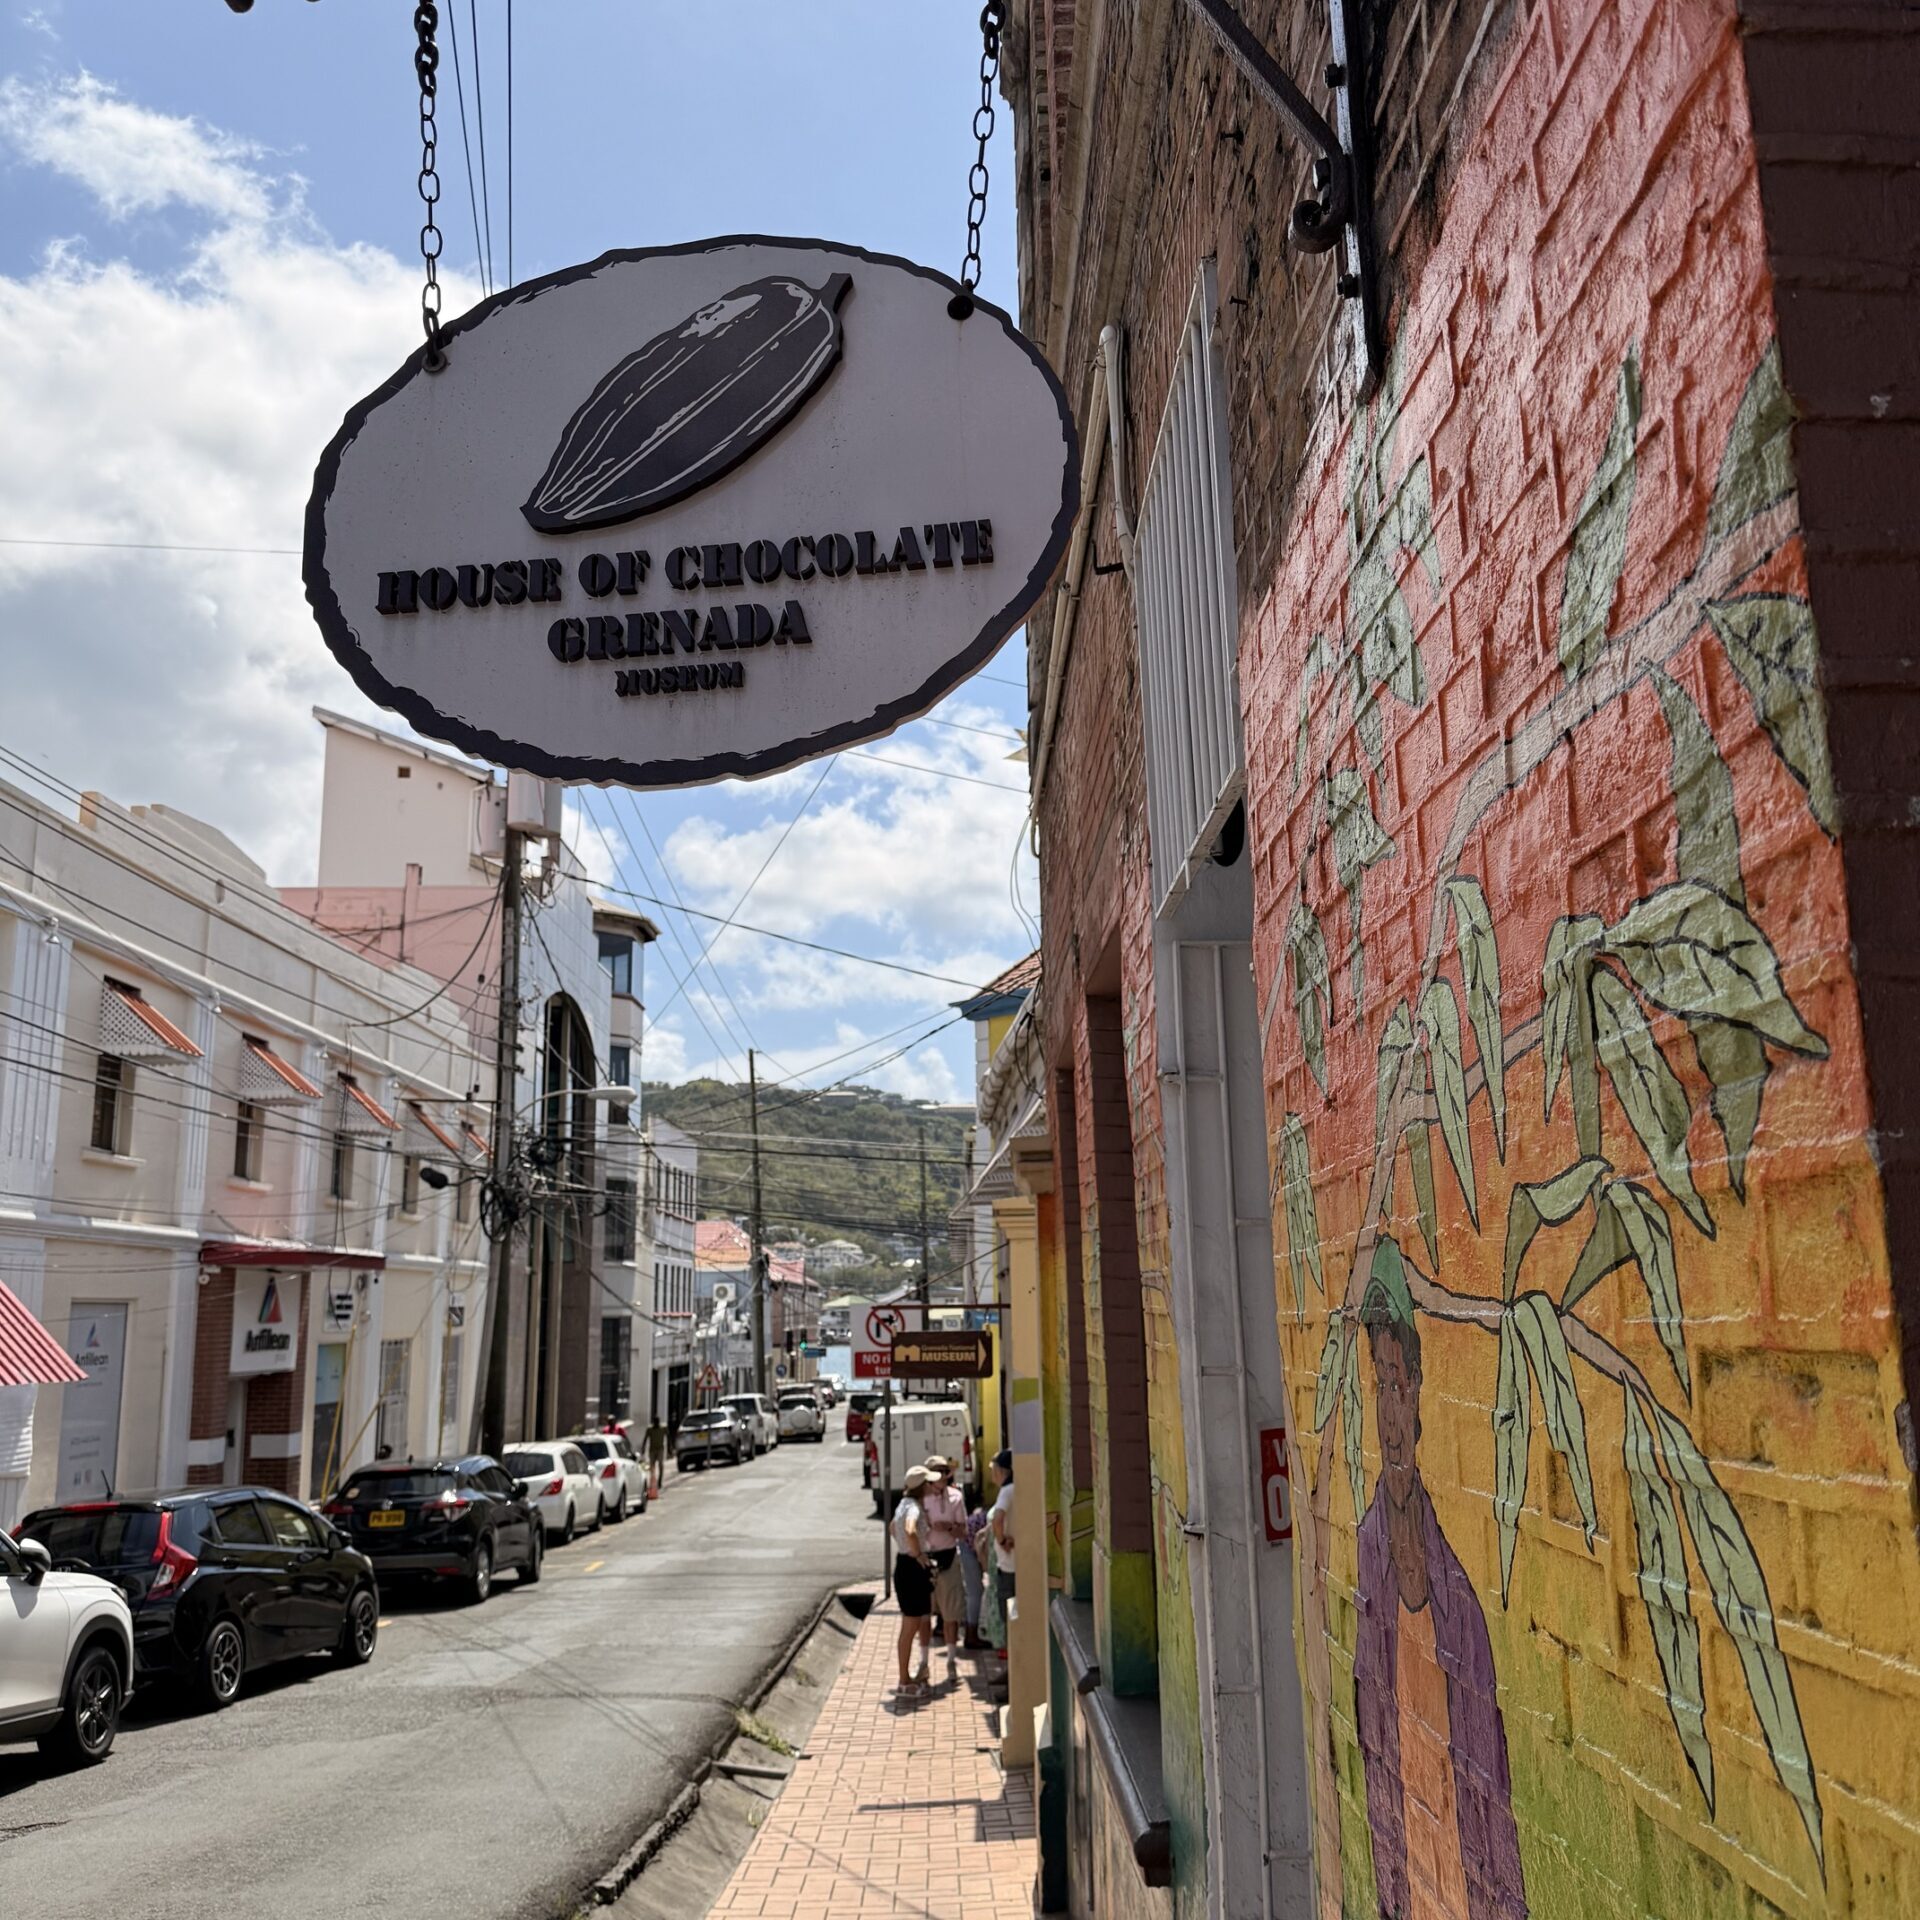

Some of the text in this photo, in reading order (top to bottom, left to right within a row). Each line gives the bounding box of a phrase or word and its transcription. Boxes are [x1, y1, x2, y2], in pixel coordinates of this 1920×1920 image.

[375, 519, 994, 615] HOUSE OF CHOCOLATE
[547, 599, 811, 663] GRENADA
[614, 661, 744, 697] MUSEUM
[862, 1353, 880, 1364] NO
[922, 1352, 976, 1361] MUSEUM
